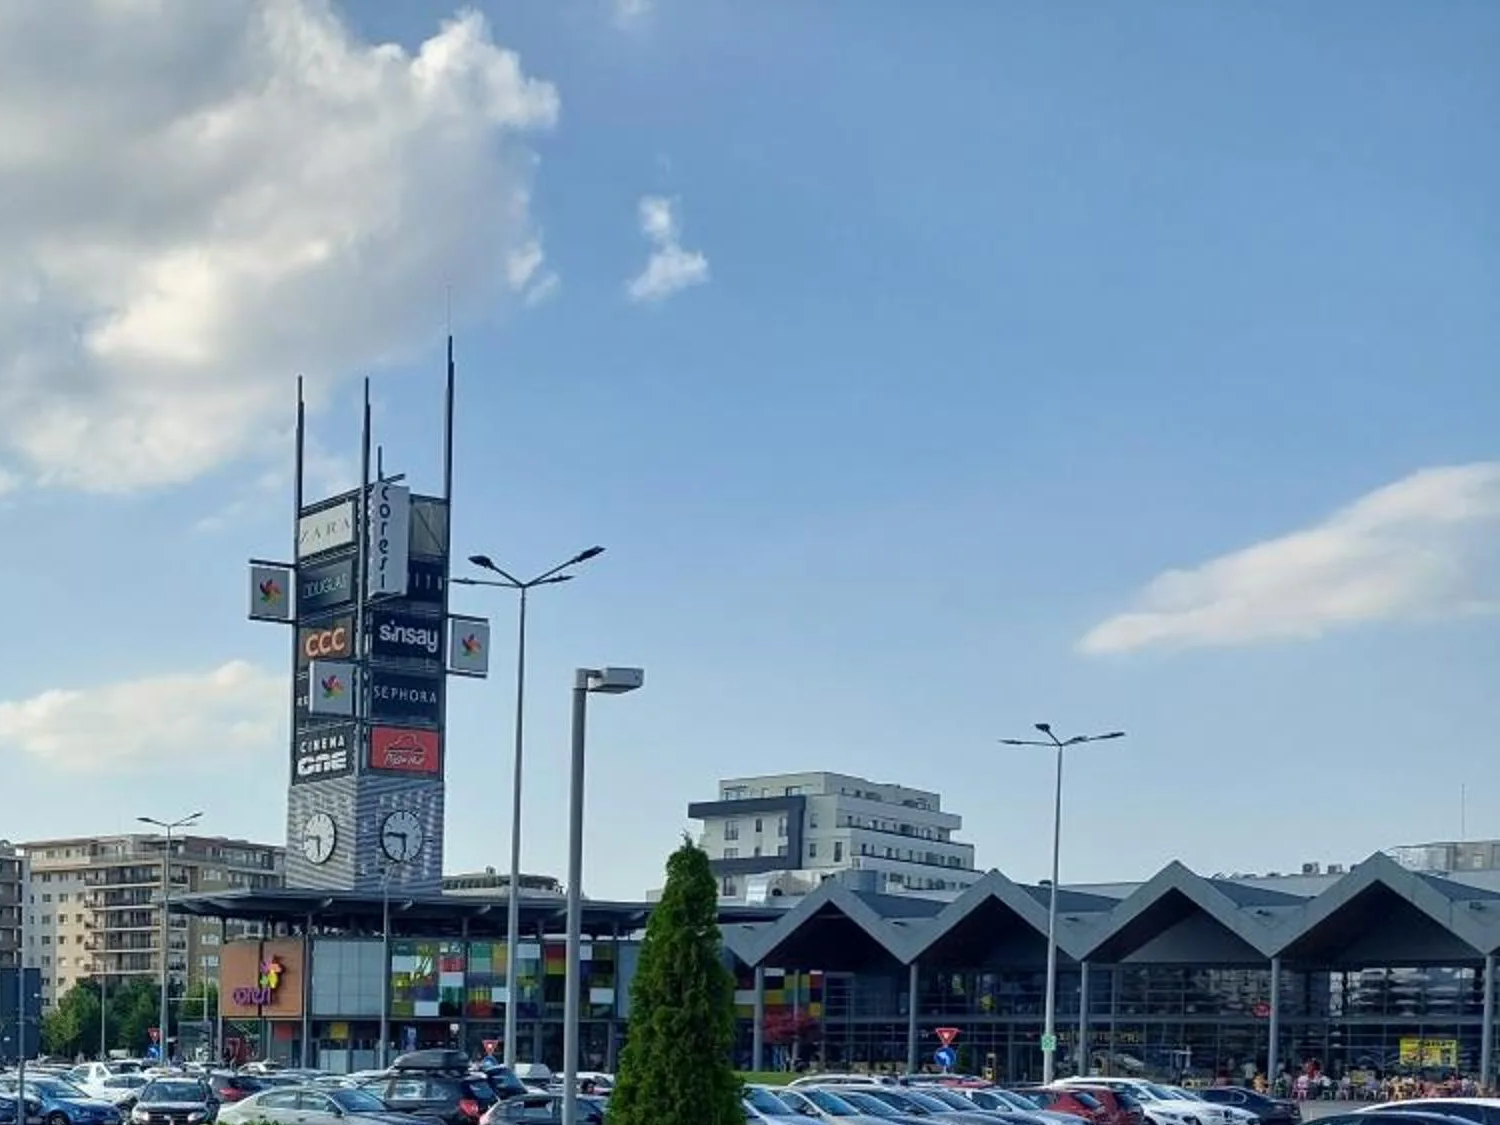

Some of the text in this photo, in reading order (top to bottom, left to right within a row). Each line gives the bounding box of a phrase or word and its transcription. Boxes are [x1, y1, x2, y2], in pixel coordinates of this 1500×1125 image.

[300, 516, 351, 544] ZARA
[305, 627, 345, 657] CCC
[379, 619, 439, 653] sinsay
[373, 685, 437, 704] SEPHORA
[300, 735, 345, 753] CINEMA
